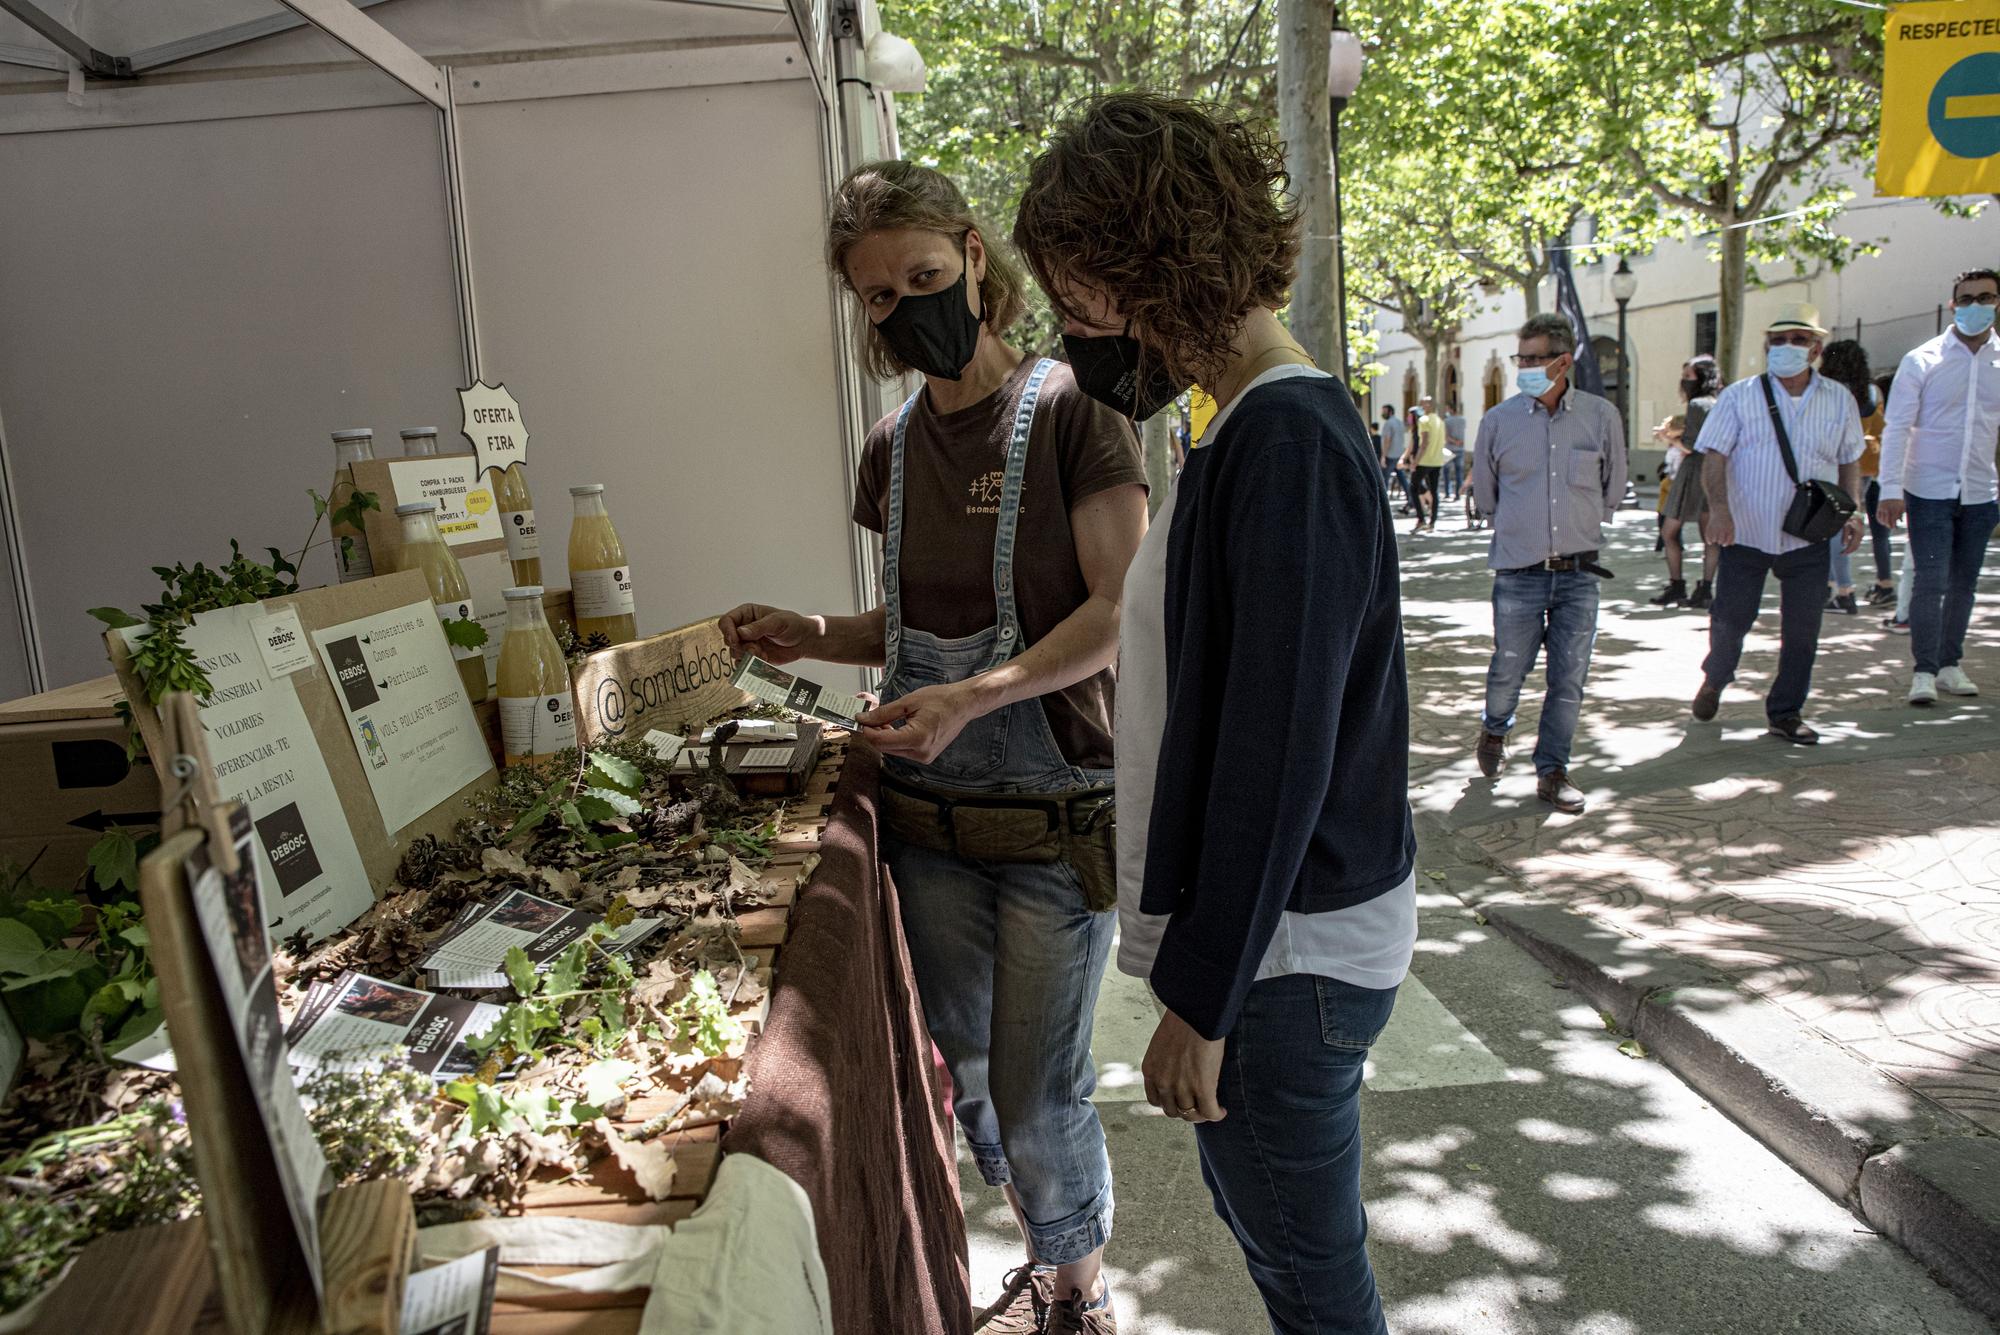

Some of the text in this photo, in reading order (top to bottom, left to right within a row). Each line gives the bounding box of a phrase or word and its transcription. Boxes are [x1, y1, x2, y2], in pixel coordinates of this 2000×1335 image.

[473, 408, 515, 424] OFERTA
[487, 435, 516, 451] FIRA
[420, 478, 441, 487] COMPRA
[448, 476, 465, 484] PACKS
[267, 631, 296, 648] DEBOSC
[369, 616, 425, 643] Cooperatives de
[194, 651, 242, 672] ENS UNA
[372, 646, 399, 663] Consum
[338, 663, 367, 682] DEBOSC
[387, 663, 430, 687] Particulars
[199, 680, 258, 710] ARNISSERIA
[214, 711, 265, 740] VOLDRIES
[380, 720, 399, 738] VOLS
[399, 703, 435, 729] POLLASTRE
[212, 736, 291, 779] DIFERENCIAR-TE
[245, 785, 263, 802] LA
[261, 769, 295, 795] RESTA?
[270, 833, 307, 862] DEBOSC
[533, 925, 577, 953] DEBOSC
[412, 1015, 449, 1054] DEBOSC
